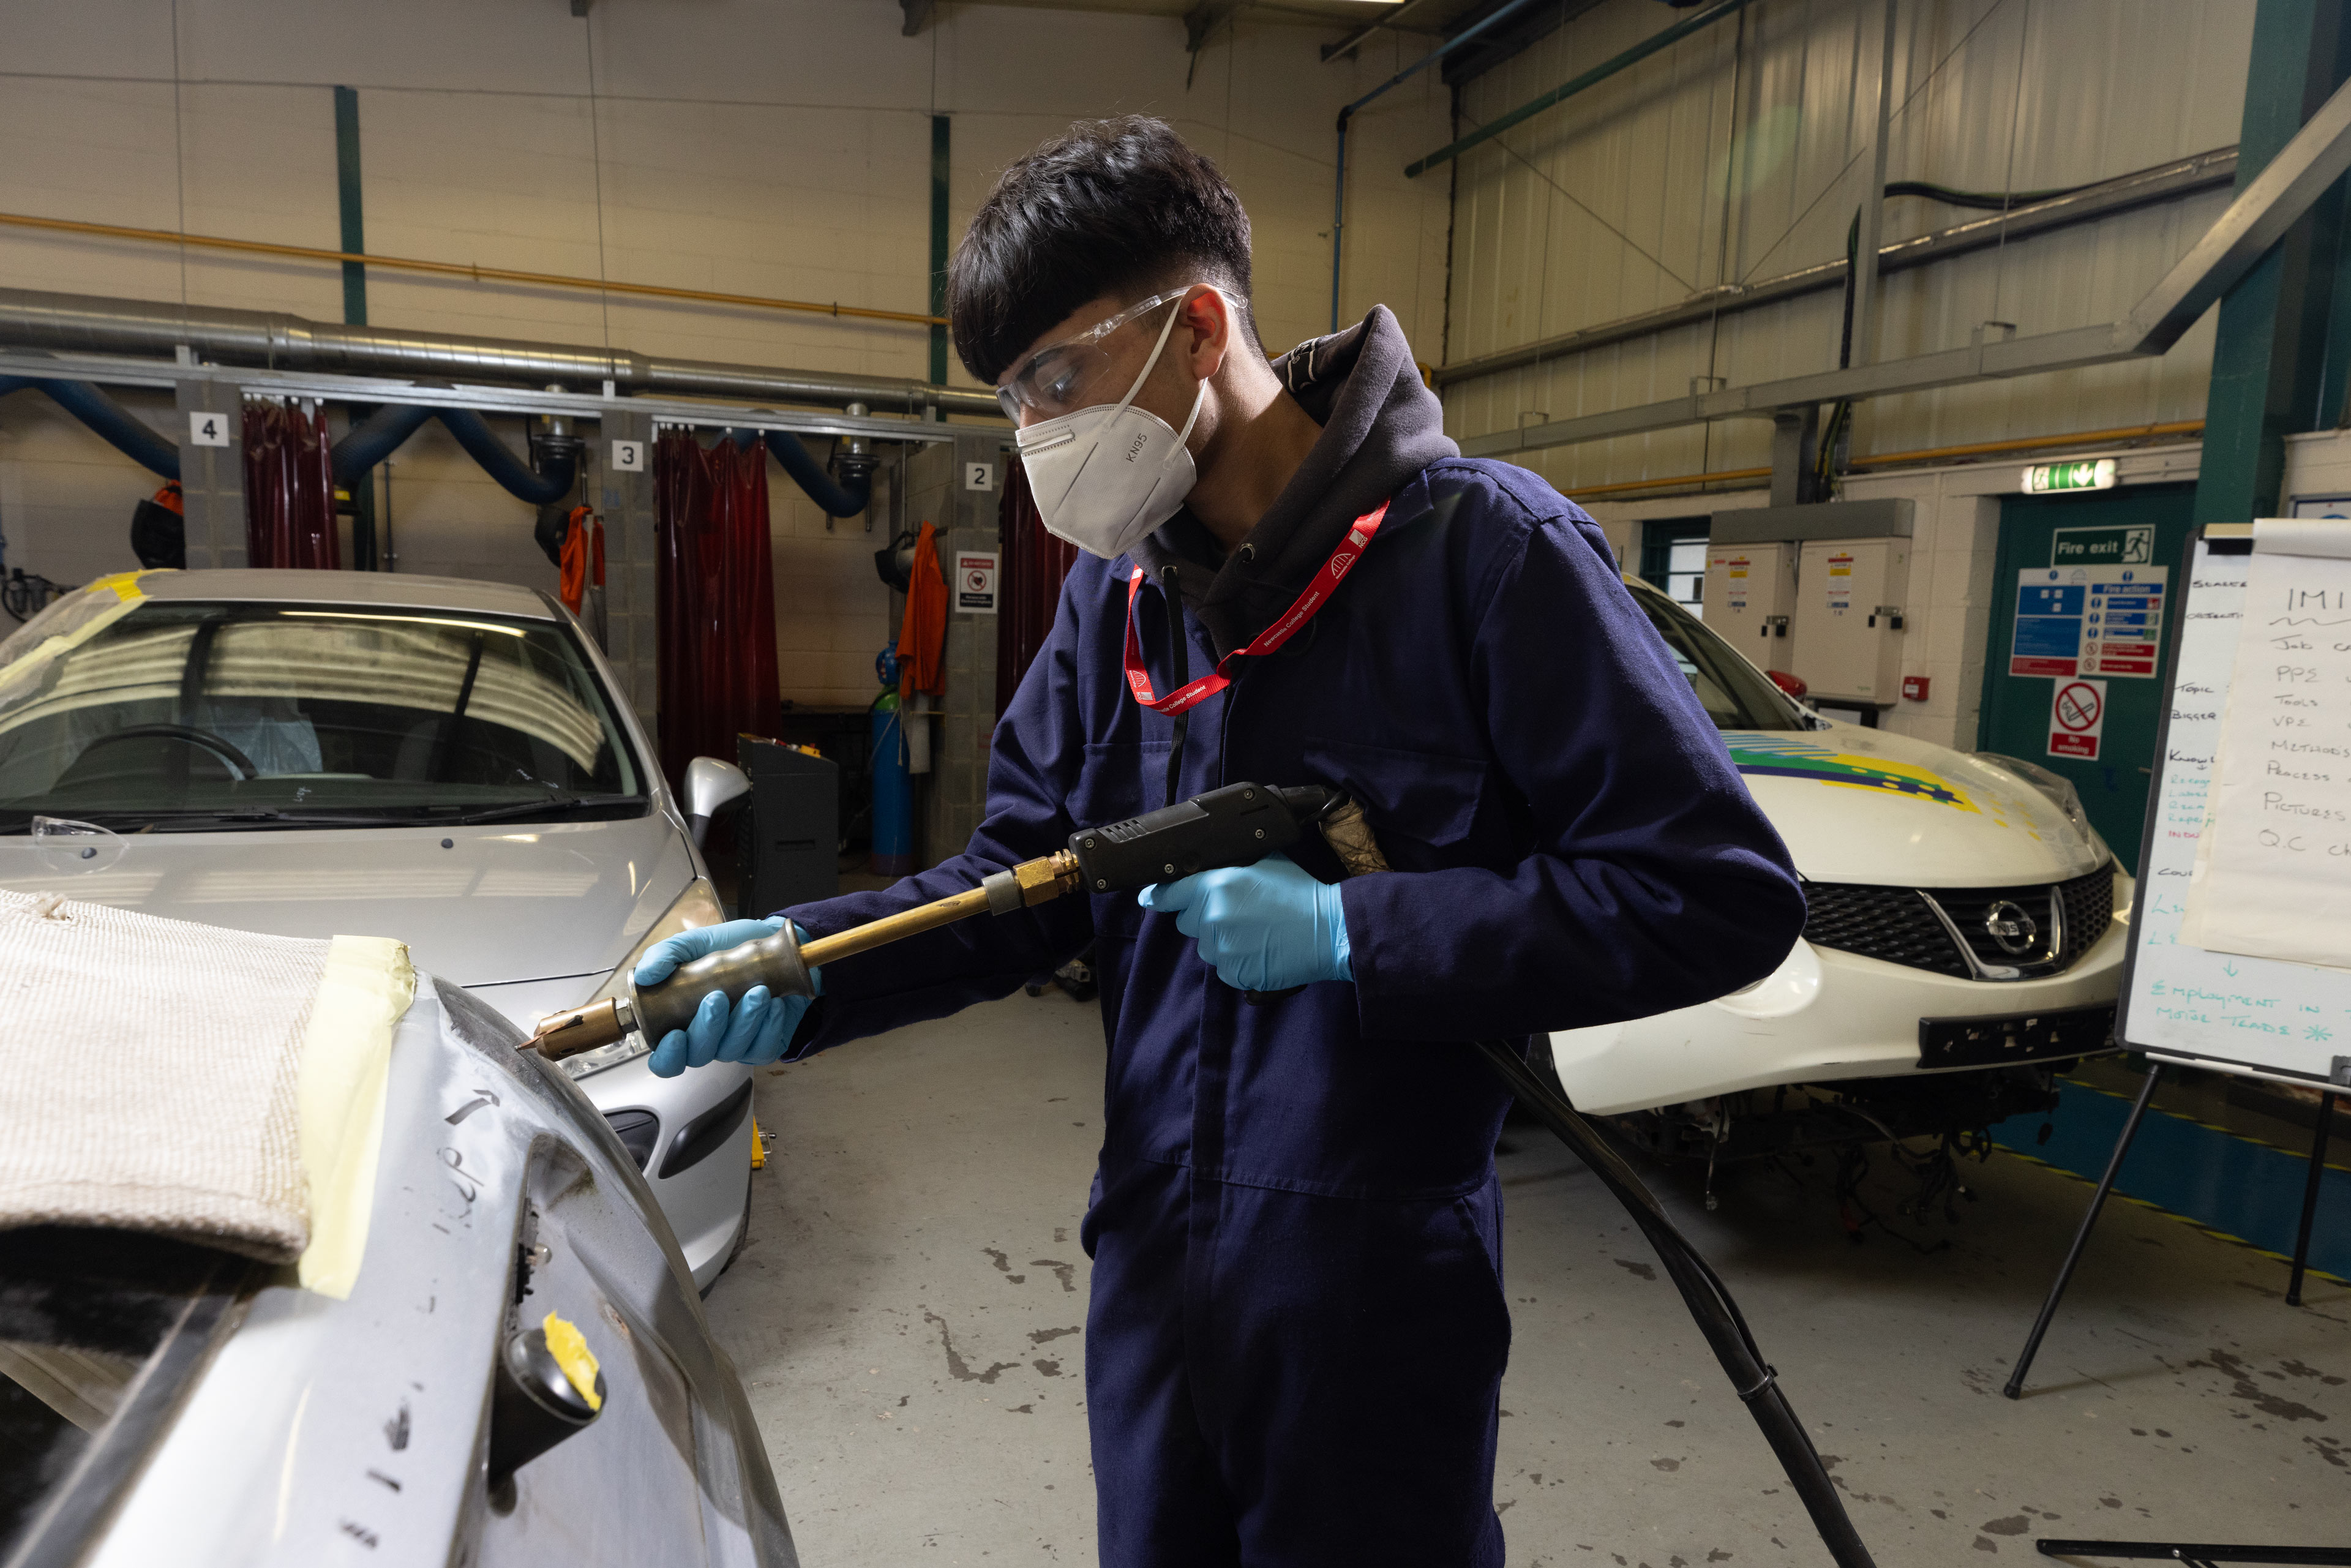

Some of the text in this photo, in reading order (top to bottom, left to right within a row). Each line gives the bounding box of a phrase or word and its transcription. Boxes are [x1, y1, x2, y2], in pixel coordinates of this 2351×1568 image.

[202, 419, 217, 439] 4
[622, 446, 634, 464] 3
[1126, 433, 1147, 463] KN95
[975, 468, 984, 484] 2
[1358, 536, 1368, 549] NCG
[2058, 540, 2118, 555] Fire exit
[1264, 591, 1320, 647] Newcastle College Student
[1169, 697, 1187, 709] College
[1185, 685, 1206, 699] Student
[2068, 735, 2080, 744] No
[2058, 743, 2090, 756] smoking
